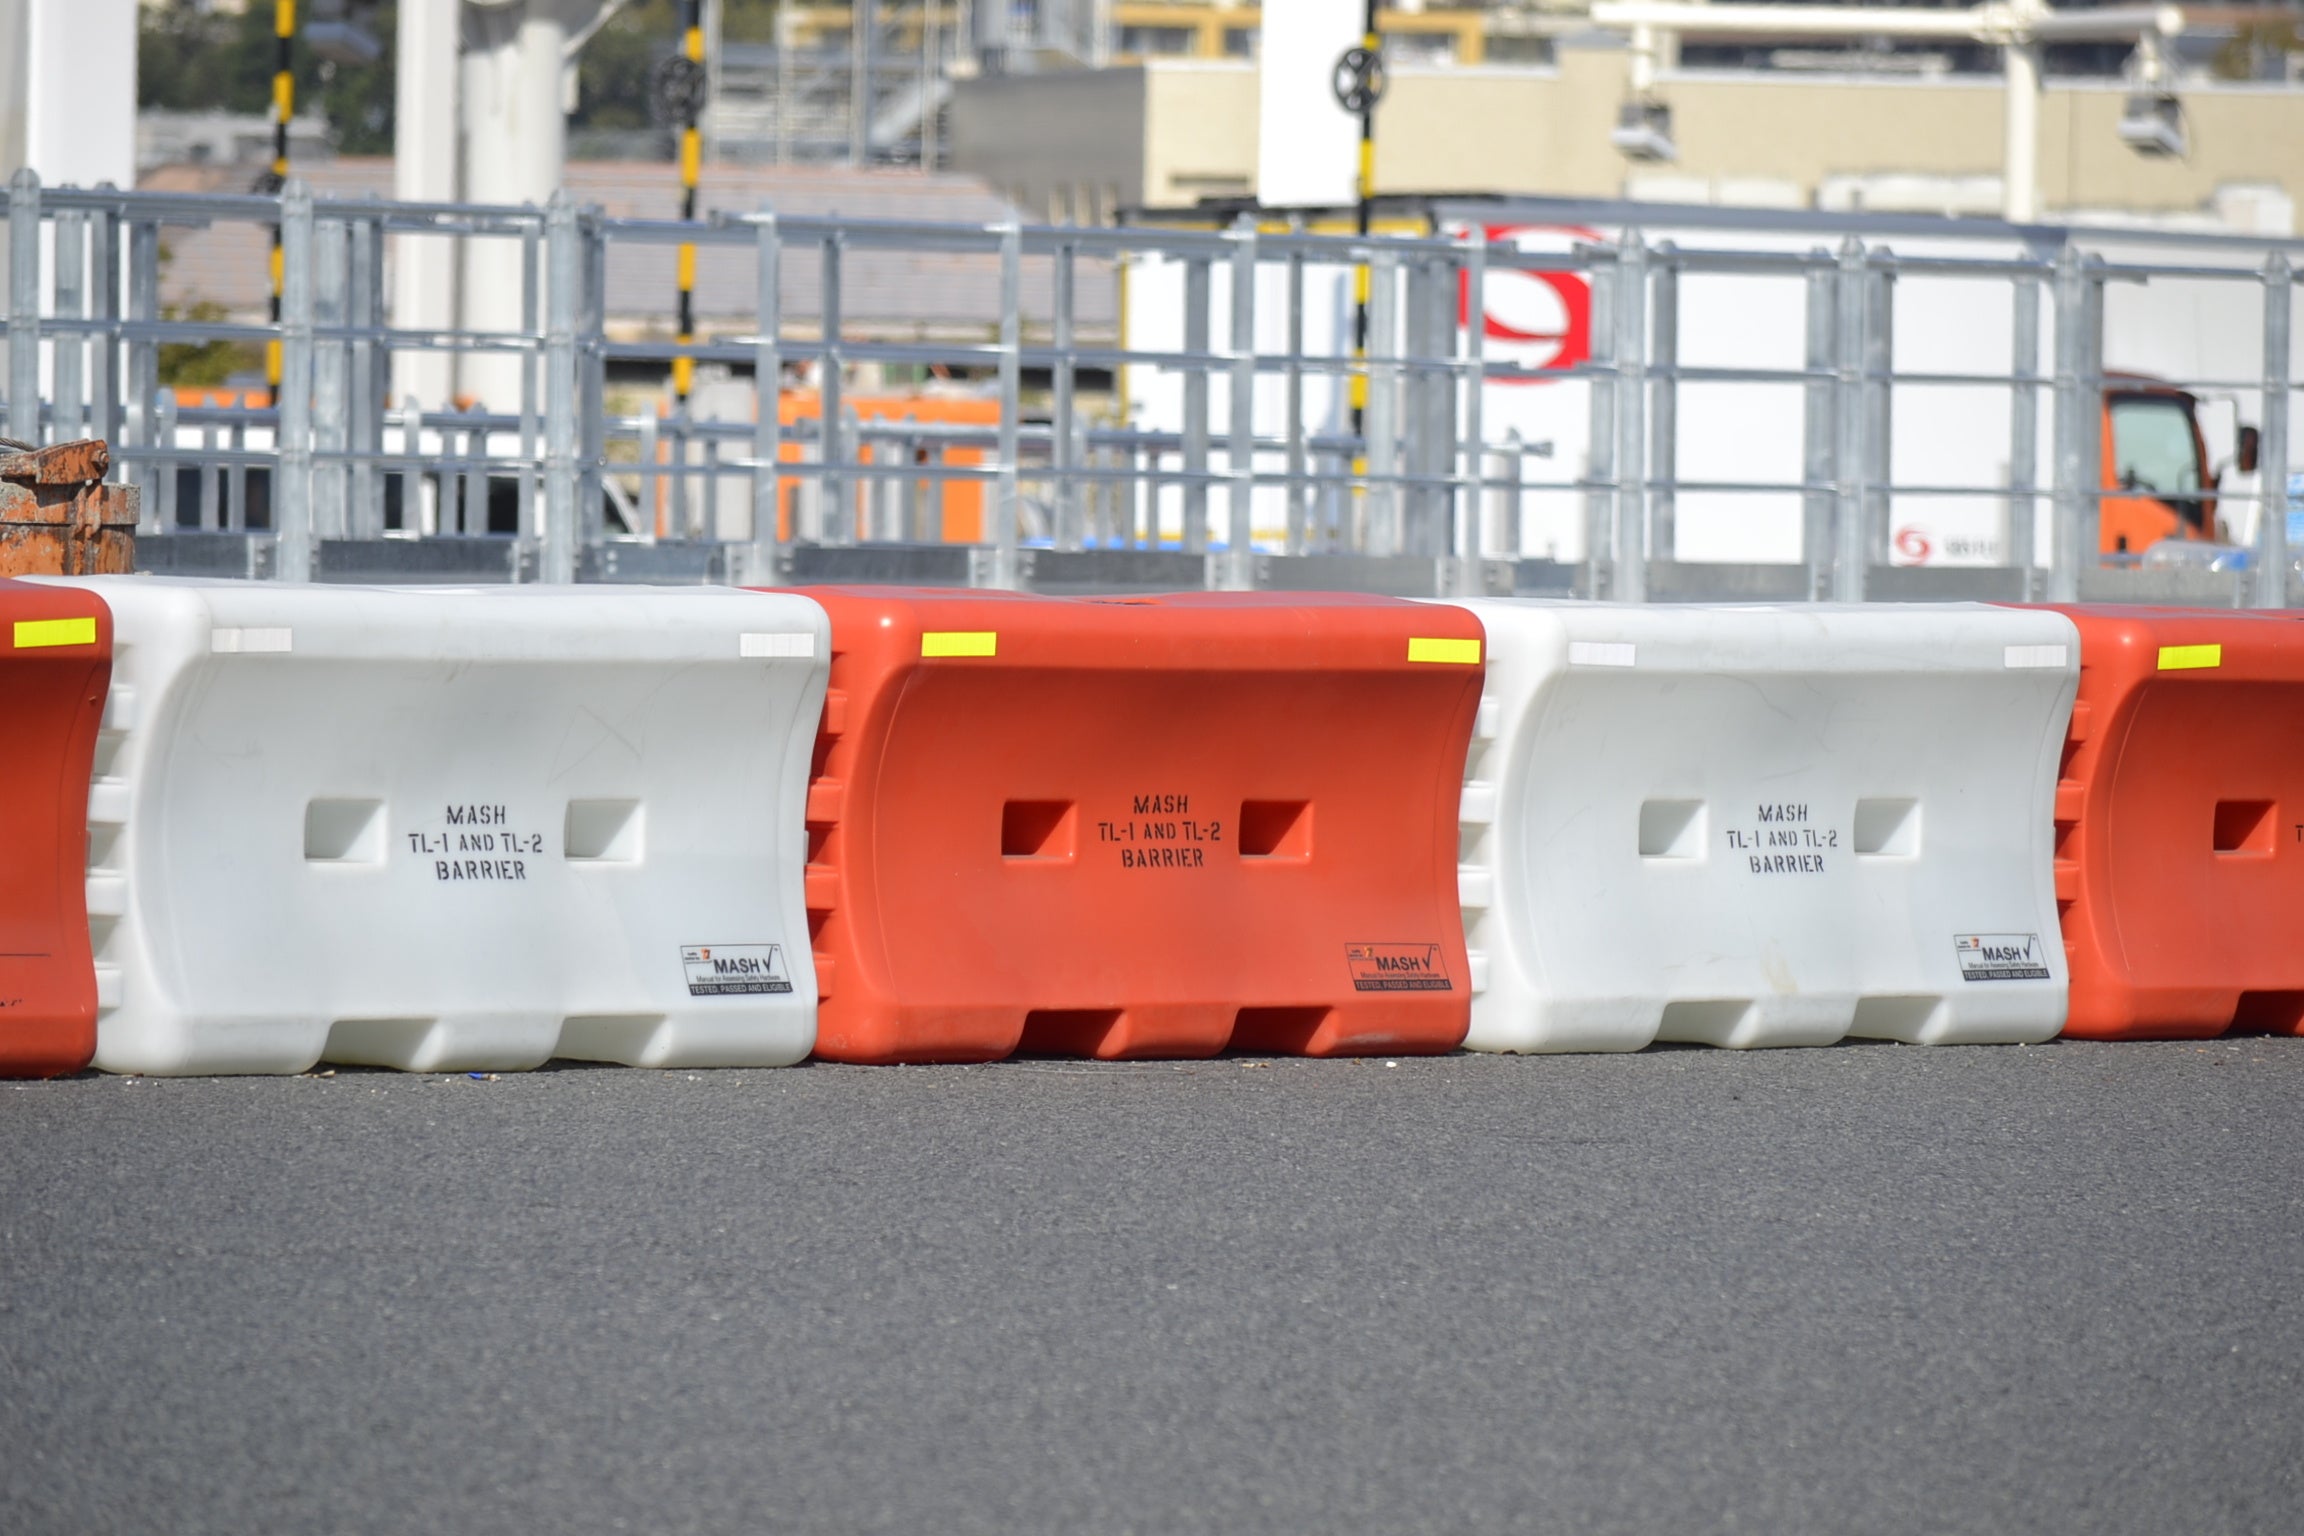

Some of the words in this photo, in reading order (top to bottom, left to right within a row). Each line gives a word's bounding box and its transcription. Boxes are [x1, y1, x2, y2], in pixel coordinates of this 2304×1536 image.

[1133, 794, 1188, 814] MASH
[1758, 803, 1808, 822] MASH
[446, 804, 505, 825] MASH
[1144, 822, 1176, 839] AND
[1182, 821, 1221, 841] TL-2
[1769, 830, 1798, 847] AND
[1803, 829, 1838, 848] TL-2
[460, 833, 494, 851] AND
[500, 833, 542, 853] TL-2
[1121, 848, 1204, 868] BARRIER
[1749, 854, 1825, 873] BARRIER
[435, 860, 526, 880] BARRIER
[1982, 947, 2021, 961] MASH
[713, 958, 760, 974] MASH
[1376, 957, 1420, 971] MASH
[720, 984, 747, 993] PASSED
[748, 984, 761, 993] AND
[762, 983, 791, 992] ELIGIBLE
